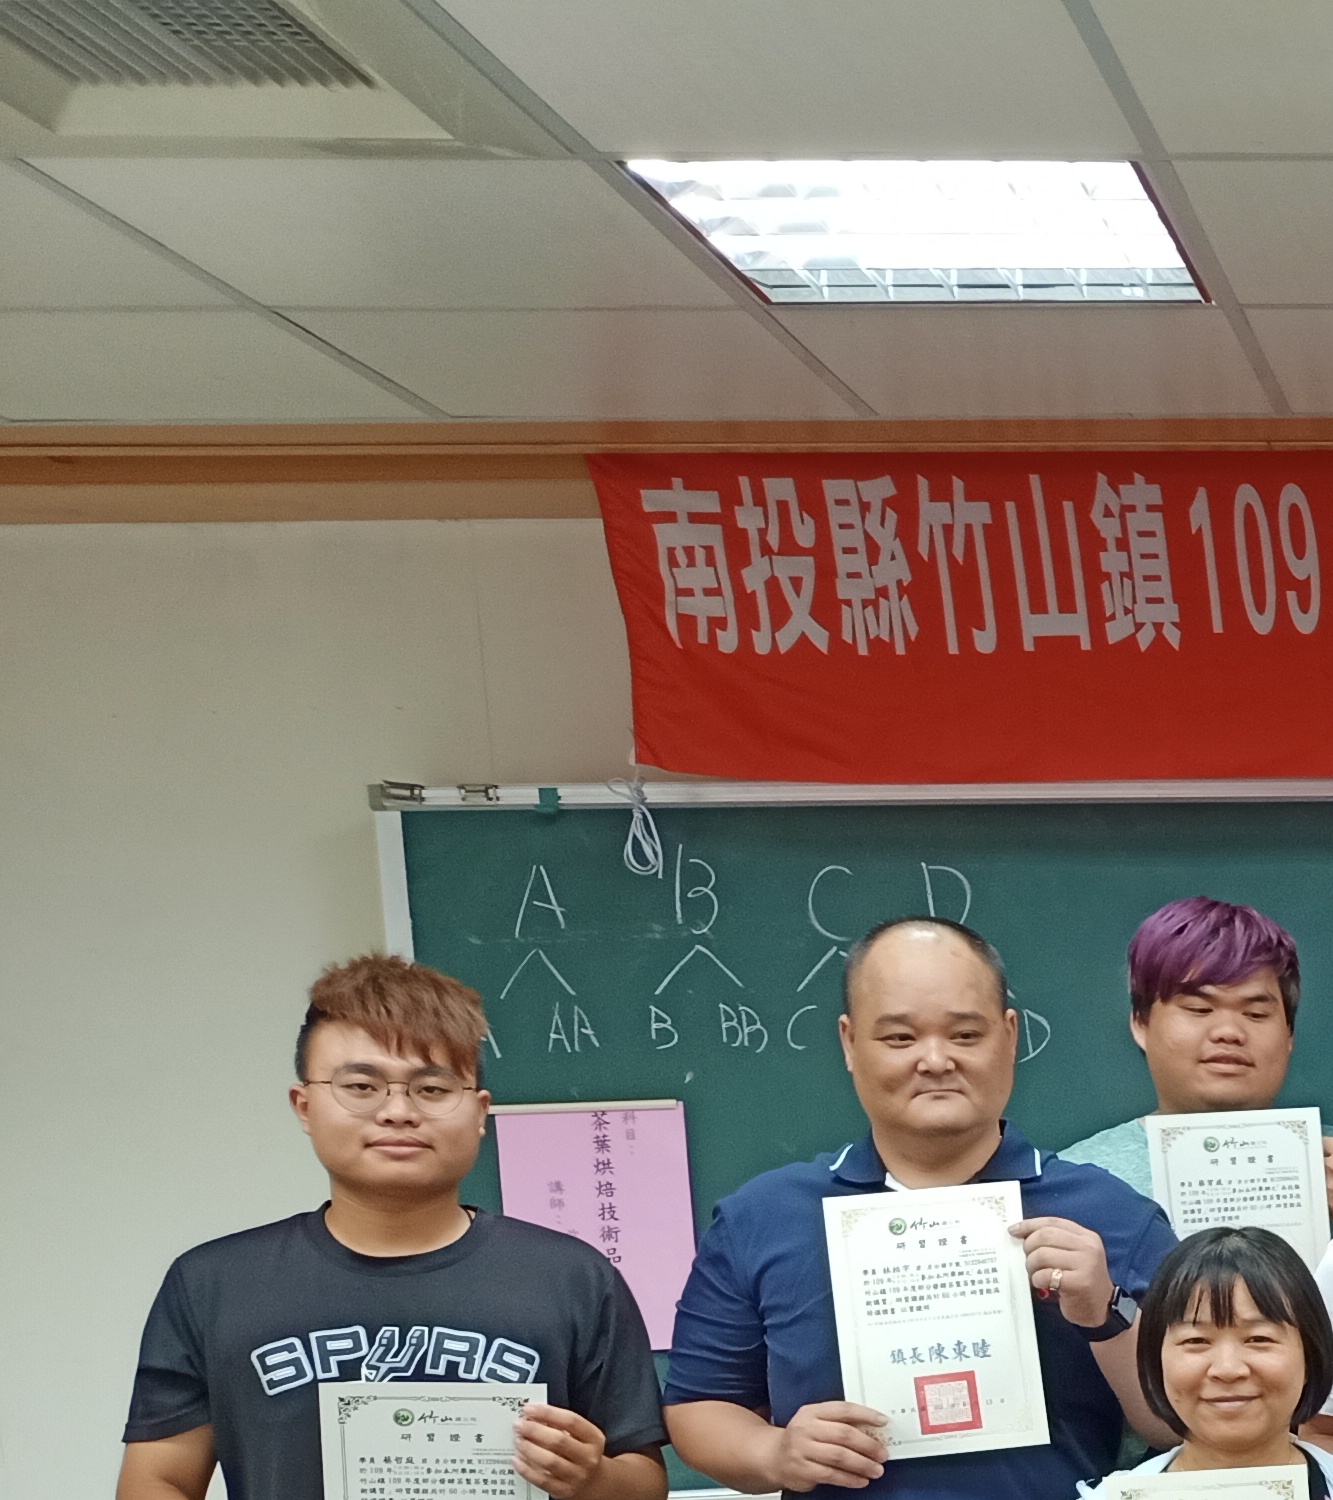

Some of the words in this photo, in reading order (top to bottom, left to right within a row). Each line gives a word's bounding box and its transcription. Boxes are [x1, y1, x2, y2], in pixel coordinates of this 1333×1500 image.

[514, 864, 566, 938] A
[675, 843, 719, 935] B
[808, 865, 855, 941] C
[649, 1004, 679, 1050] B
[786, 1004, 818, 1050] C
[250, 1324, 541, 1396] SPURS
[889, 1338, 993, 1366] 鎮長陳東睦
